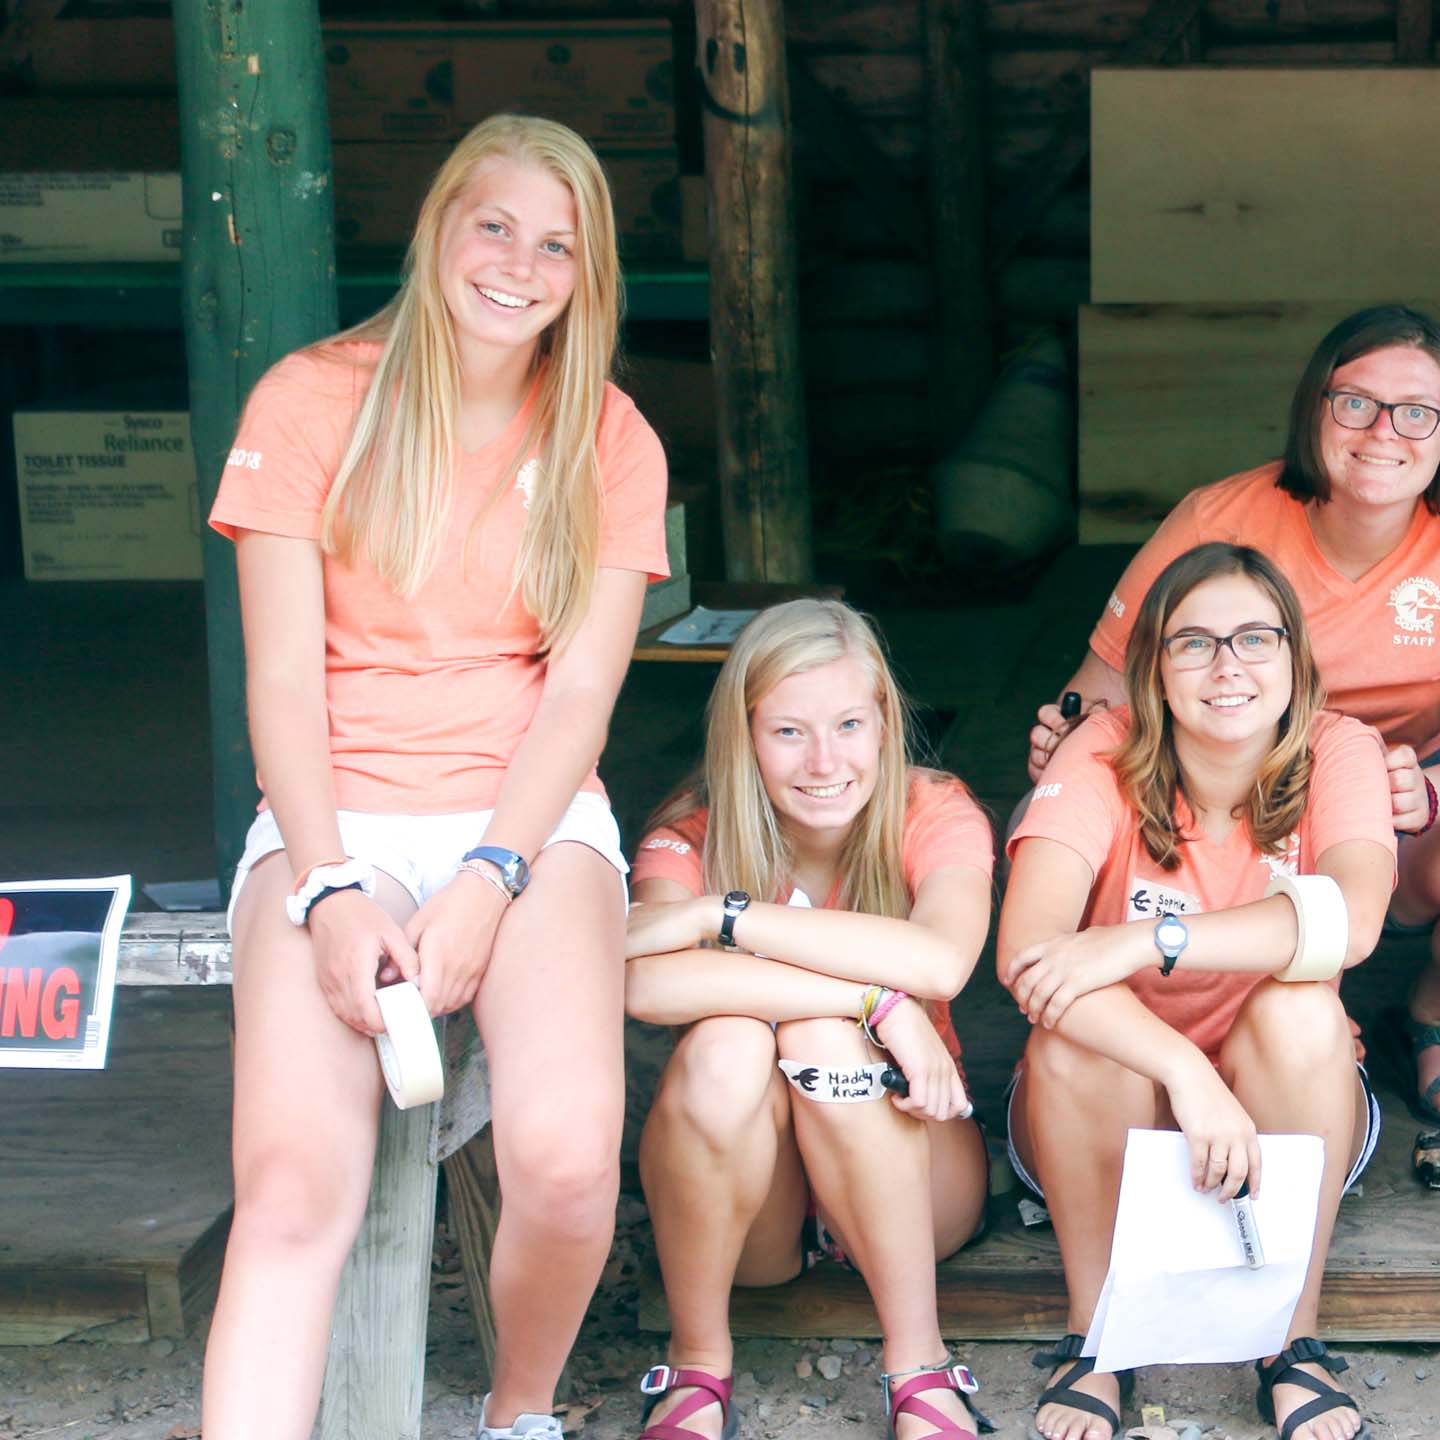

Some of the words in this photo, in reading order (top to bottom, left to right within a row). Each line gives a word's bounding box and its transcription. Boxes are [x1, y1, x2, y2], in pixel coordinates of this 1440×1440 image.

[103, 433, 184, 452] Reliance
[24, 455, 74, 468] TOILET
[77, 455, 127, 468] TISSUE
[1392, 634, 1436, 647] STAFF
[645, 838, 691, 856] 2018
[1158, 894, 1185, 911] Sophie
